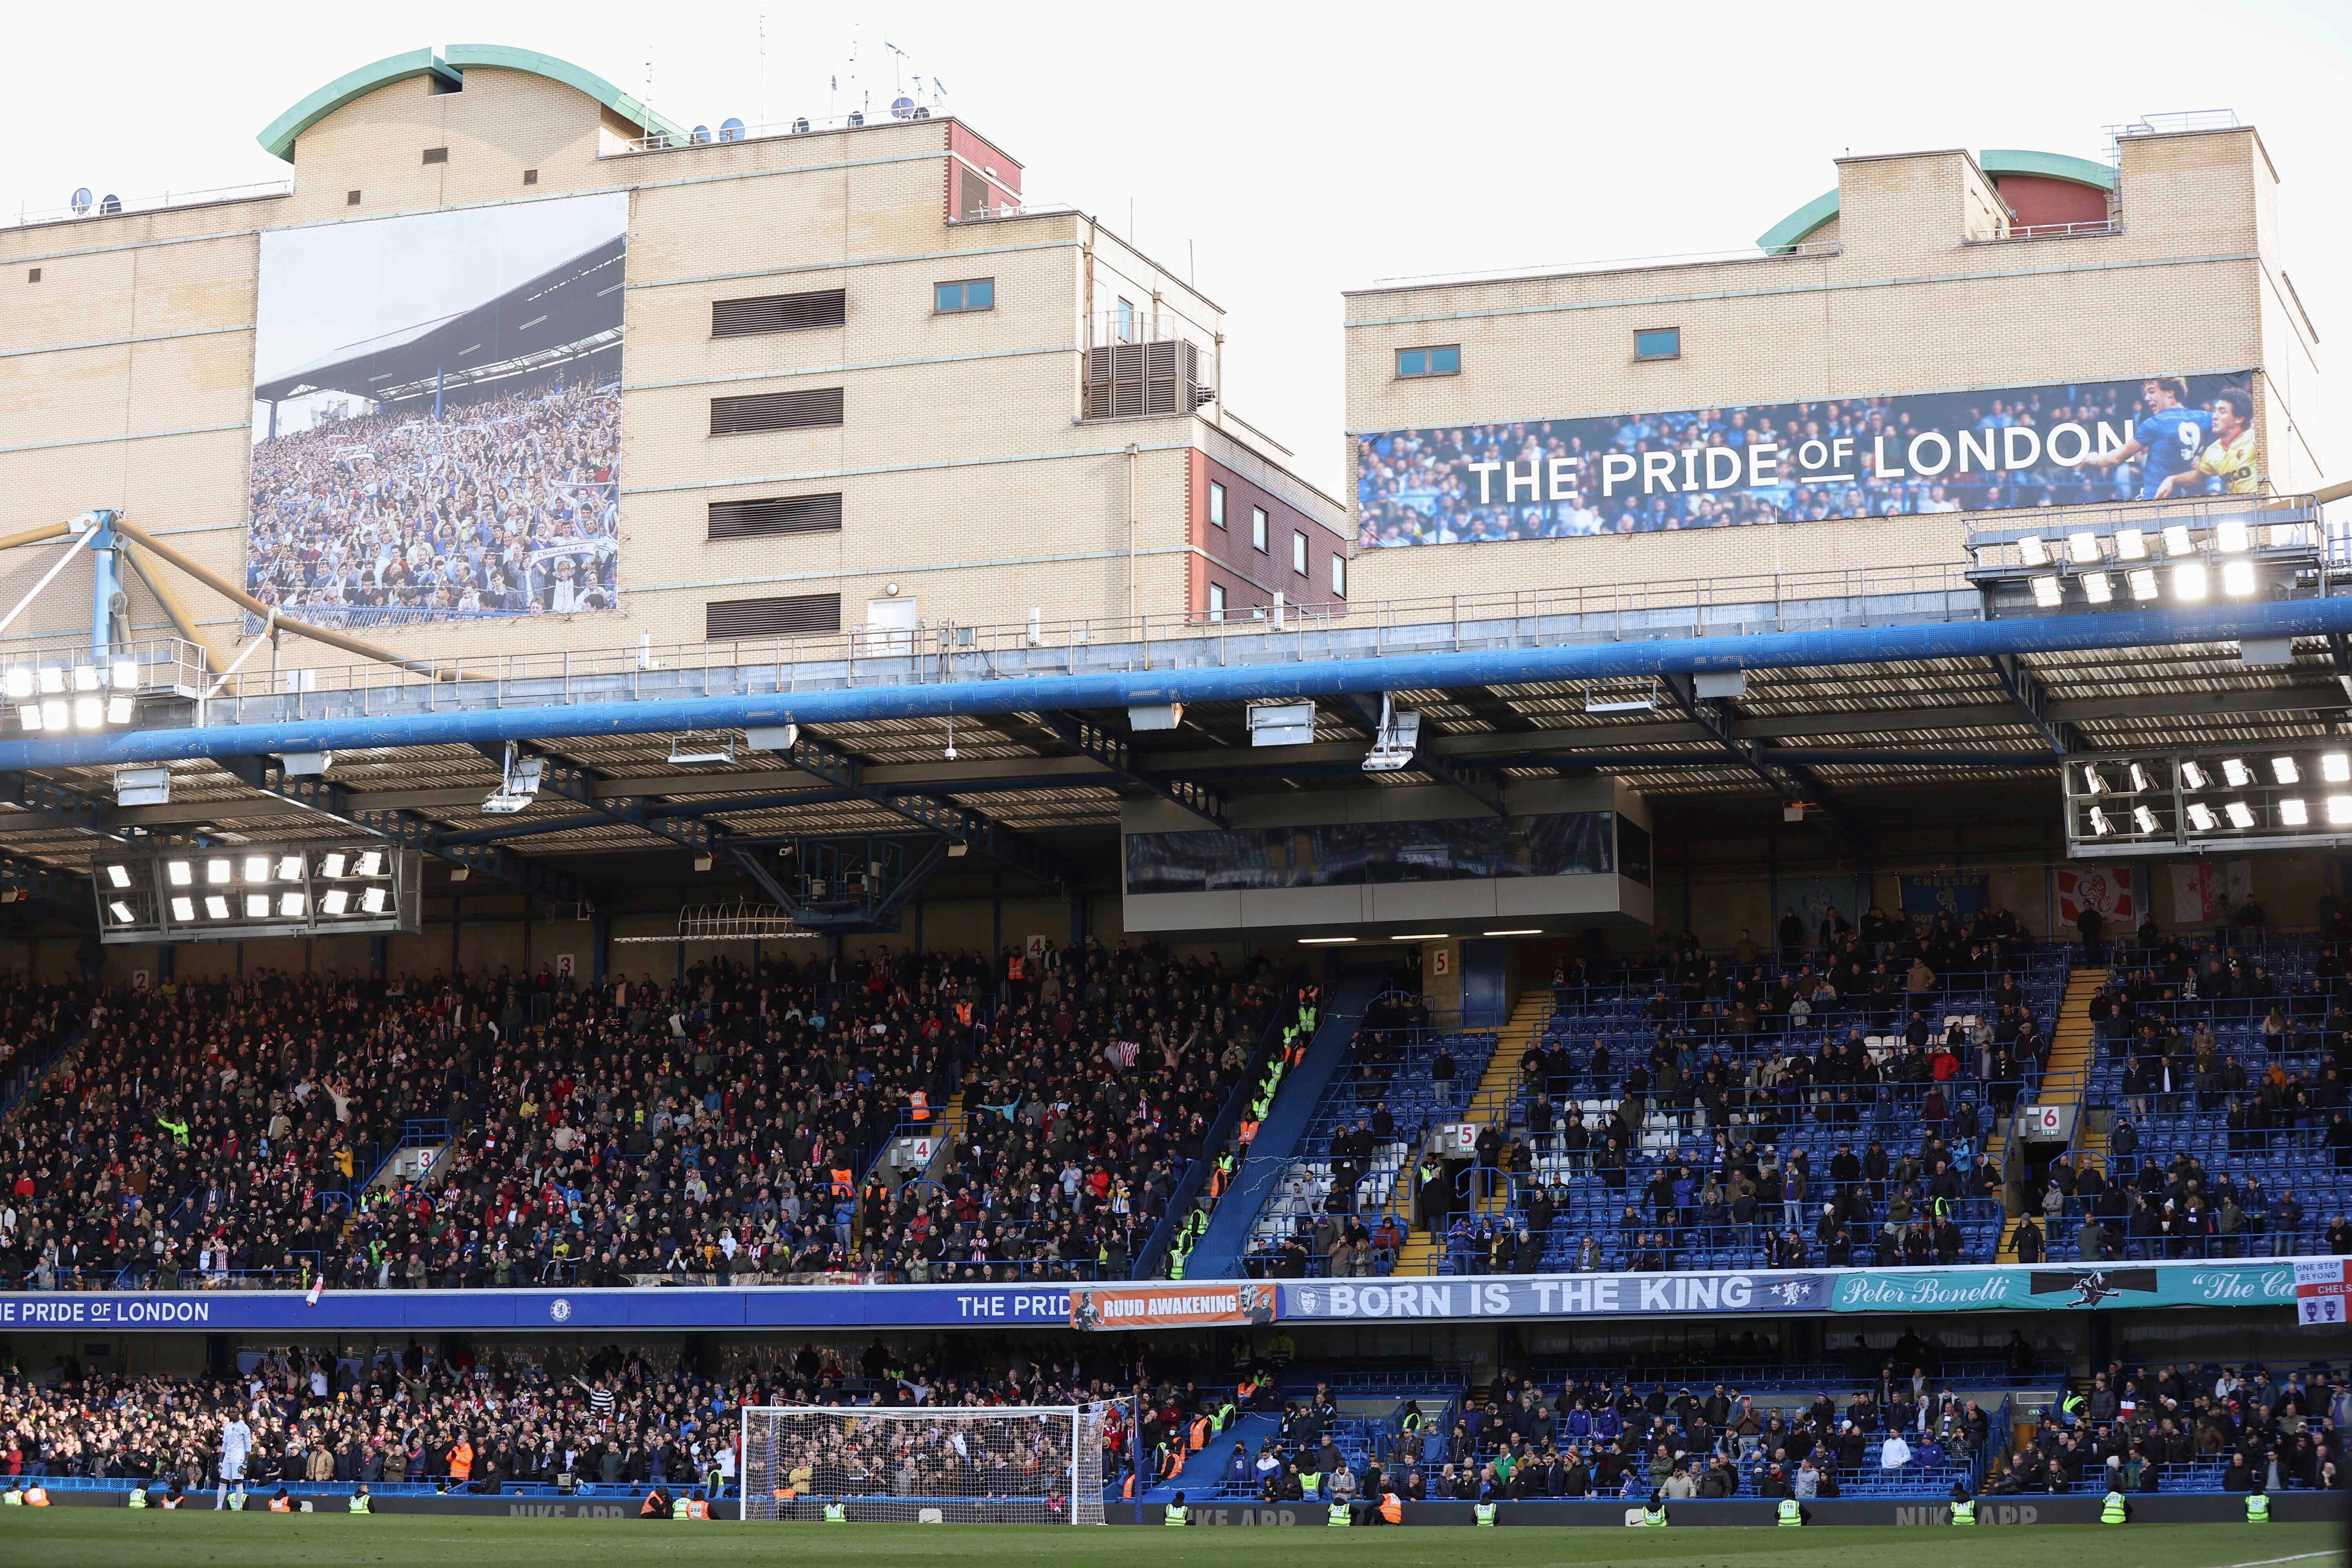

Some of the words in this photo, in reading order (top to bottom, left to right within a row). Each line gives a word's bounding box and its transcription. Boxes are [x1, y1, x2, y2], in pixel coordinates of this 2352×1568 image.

[2178, 421, 2200, 461] 9
[1468, 457, 1579, 504] THE
[1603, 443, 1779, 497] PRIDE
[1798, 438, 1853, 470] OF
[1874, 419, 2135, 478] LONDON
[537, 546, 571, 557] CHELSEA
[1913, 876, 1980, 886] CHELSEA
[1029, 937, 1043, 955] 4
[561, 957, 571, 973] 3
[1436, 953, 1445, 972] 5
[136, 972, 146, 989] 2
[2043, 1109, 2057, 1127] 6
[1461, 1127, 1473, 1144] 5
[916, 1141, 928, 1158] 4
[421, 1152, 430, 1168] 3
[2300, 1272, 2337, 1280] BEYOND
[1329, 1285, 1451, 1316] BORN
[1470, 1283, 1511, 1314] IS
[1531, 1279, 1619, 1312] THE
[1640, 1276, 1753, 1310] KING
[1842, 1278, 1906, 1304] Peter
[1911, 1276, 2010, 1303] Bonetti
[22, 1303, 84, 1321] PRIDE
[91, 1303, 111, 1316] OF
[117, 1302, 209, 1321] LONDON
[957, 1296, 1005, 1317] THE
[1103, 1299, 1145, 1318] RUUD
[1147, 1295, 1236, 1316] AWAKENING
[1236, 1460, 1243, 1469] 3
[510, 1504, 566, 1518] NIKE
[577, 1505, 624, 1519] APP
[1188, 1509, 1228, 1526] IKE
[1241, 1509, 1296, 1527] APP
[1896, 1506, 1948, 1526] NIK
[1978, 1505, 2038, 1525] APP
